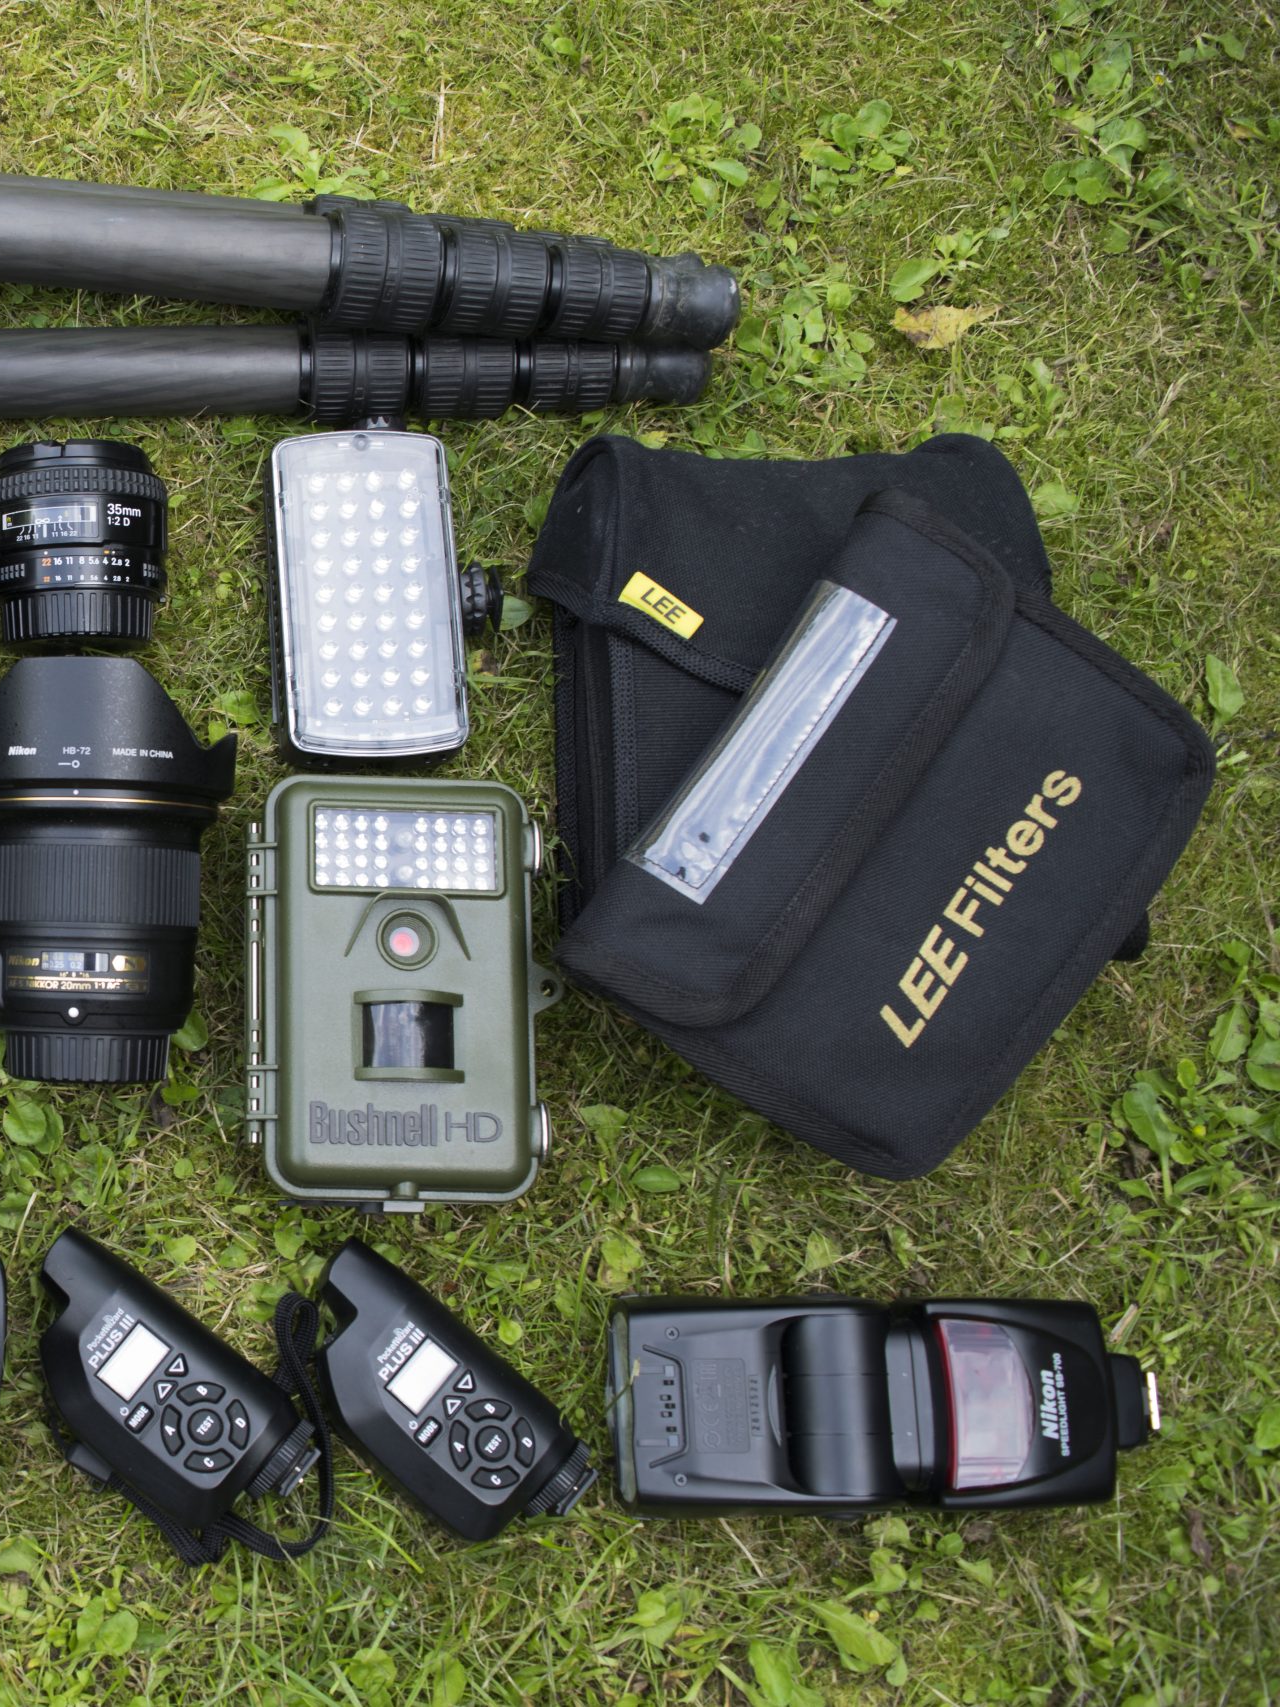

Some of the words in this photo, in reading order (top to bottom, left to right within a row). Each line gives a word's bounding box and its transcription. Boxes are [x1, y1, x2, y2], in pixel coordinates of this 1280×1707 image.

[107, 503, 142, 517] 35mm
[107, 517, 120, 526] 1:2
[123, 517, 130, 526] D
[41, 557, 52, 567] 22
[53, 557, 63, 566] 16
[65, 556, 73, 565] 11
[79, 556, 85, 565] 8
[88, 556, 99, 565] 5.6
[102, 557, 109, 565] 4
[111, 557, 122, 566] 2.8
[125, 558, 130, 567] 2
[641, 587, 687, 625] LEE
[8, 746, 37, 755] Nikon
[62, 746, 91, 755] HB-72
[112, 748, 137, 757] MADE
[139, 749, 148, 757] IN
[149, 749, 173, 759] CHINA
[879, 923, 969, 1048] LEE
[943, 770, 1082, 938] Filters
[61, 981, 91, 990] 20mm
[309, 1100, 438, 1147] Bushnell
[445, 1111, 504, 1143] HD
[86, 1308, 124, 1352] PocketWizard
[88, 1330, 123, 1369] PLUS
[119, 1313, 135, 1332] III
[377, 1321, 415, 1365] PocketWizard
[378, 1342, 414, 1381] PLUS
[409, 1328, 426, 1346] III
[1052, 1352, 1065, 1389] SB-700
[196, 1385, 208, 1396] B
[484, 1403, 496, 1415] B
[1040, 1369, 1060, 1440] Nikon
[128, 1406, 149, 1428] MODE
[234, 1417, 246, 1429] D
[1057, 1390, 1071, 1457] SPEEDLIGHT
[164, 1425, 176, 1436] A
[196, 1415, 215, 1436] TEST
[418, 1420, 439, 1444] MODE
[453, 1441, 465, 1452] A
[484, 1434, 503, 1454] TEST
[521, 1437, 533, 1448] D
[203, 1457, 215, 1468] C
[490, 1474, 502, 1486] C
